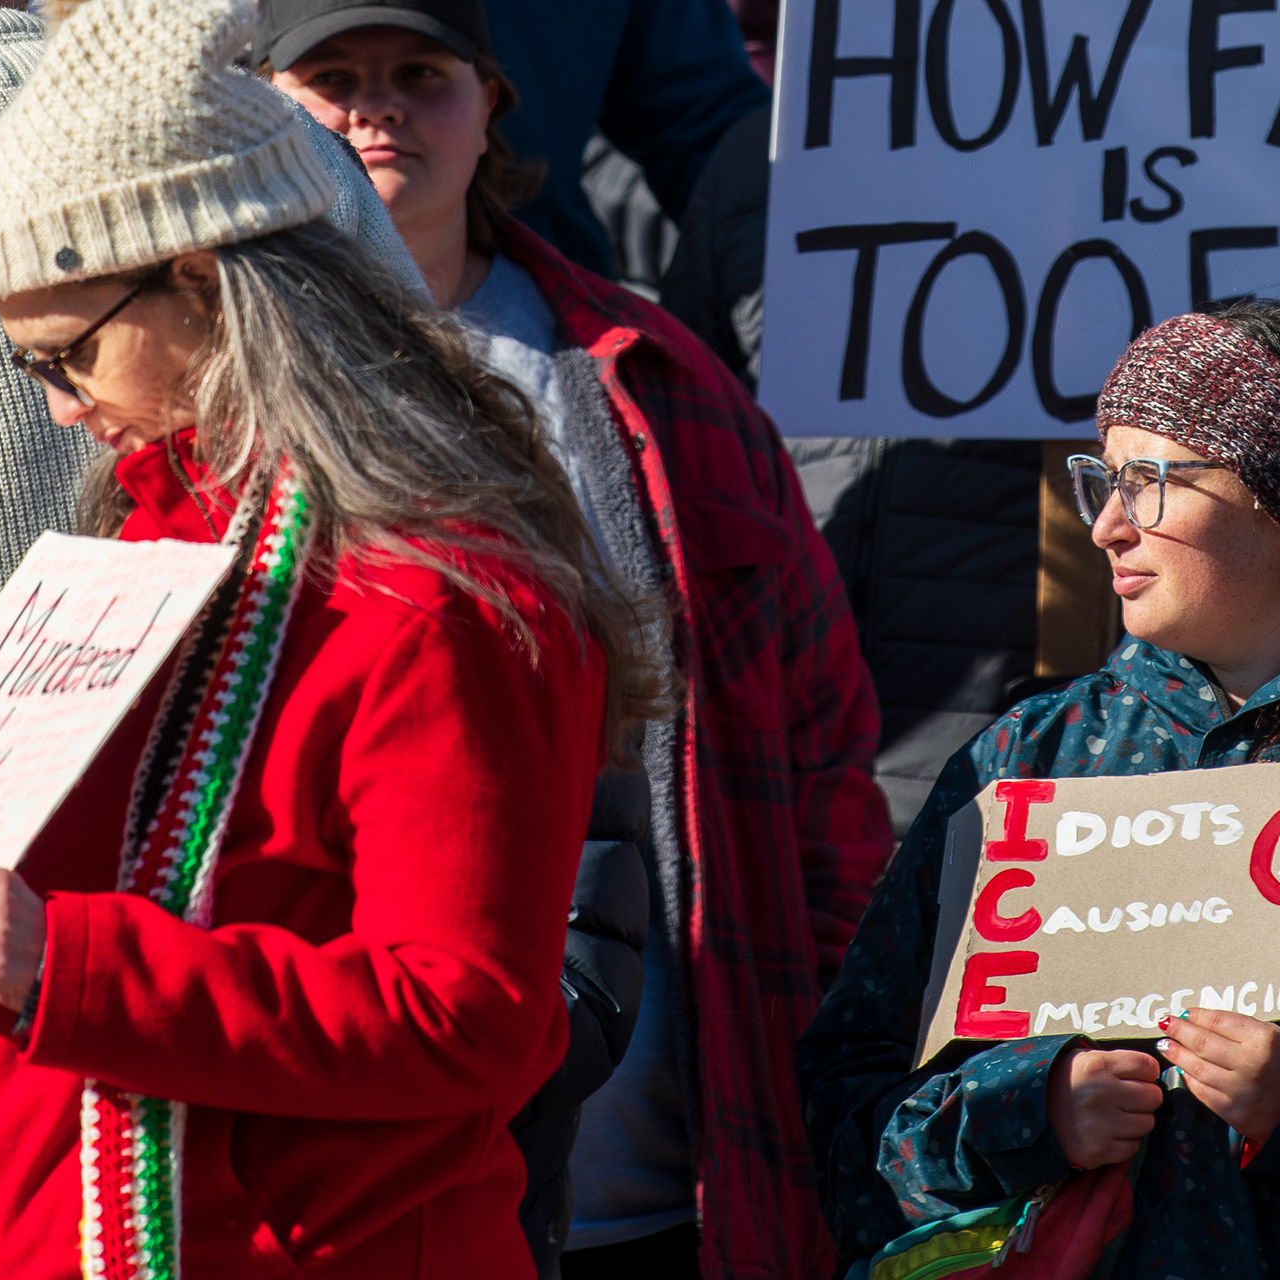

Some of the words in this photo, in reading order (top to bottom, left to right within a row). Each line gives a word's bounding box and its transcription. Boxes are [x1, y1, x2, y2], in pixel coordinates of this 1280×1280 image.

[1101, 145, 1198, 223] IS
[795, 221, 1153, 424] TOO
[986, 780, 1245, 862] IDIOTS
[973, 867, 1234, 943] CAUSING
